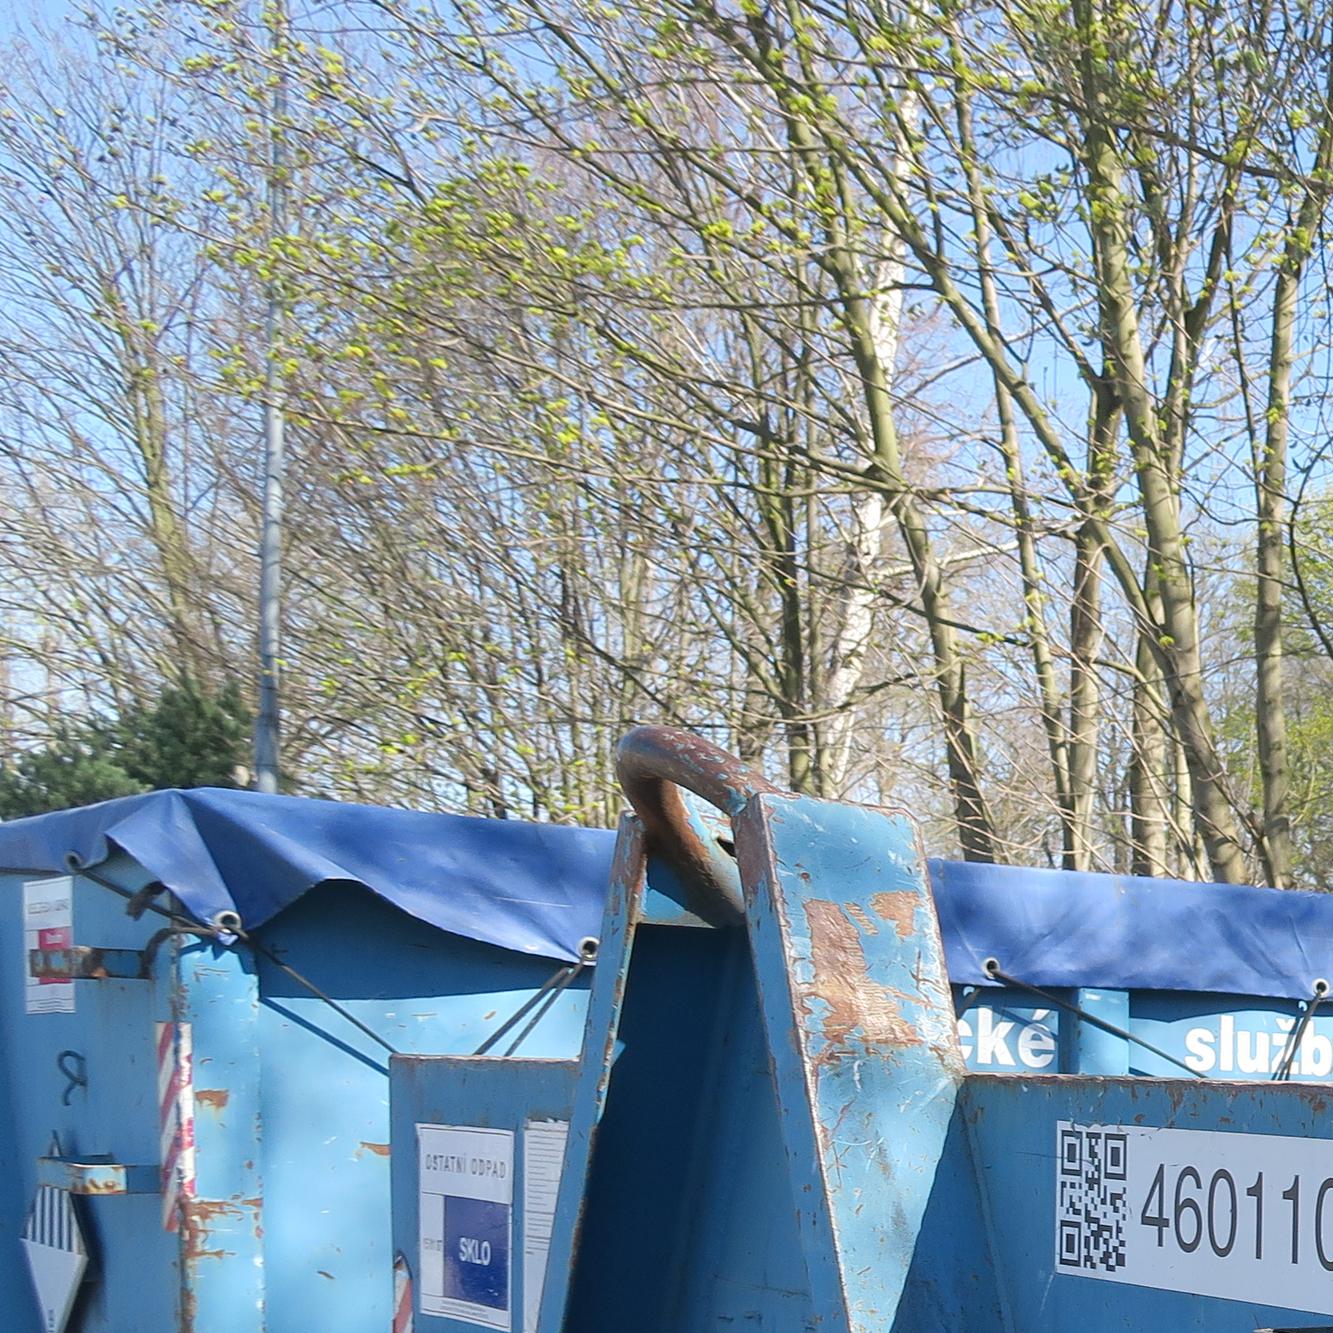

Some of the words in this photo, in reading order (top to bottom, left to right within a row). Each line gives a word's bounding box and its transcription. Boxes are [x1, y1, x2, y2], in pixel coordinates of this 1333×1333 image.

[425, 1152, 467, 1175] OSTATNÍ
[470, 1157, 507, 1180] ODPAD
[458, 1236, 492, 1267] SKLO
